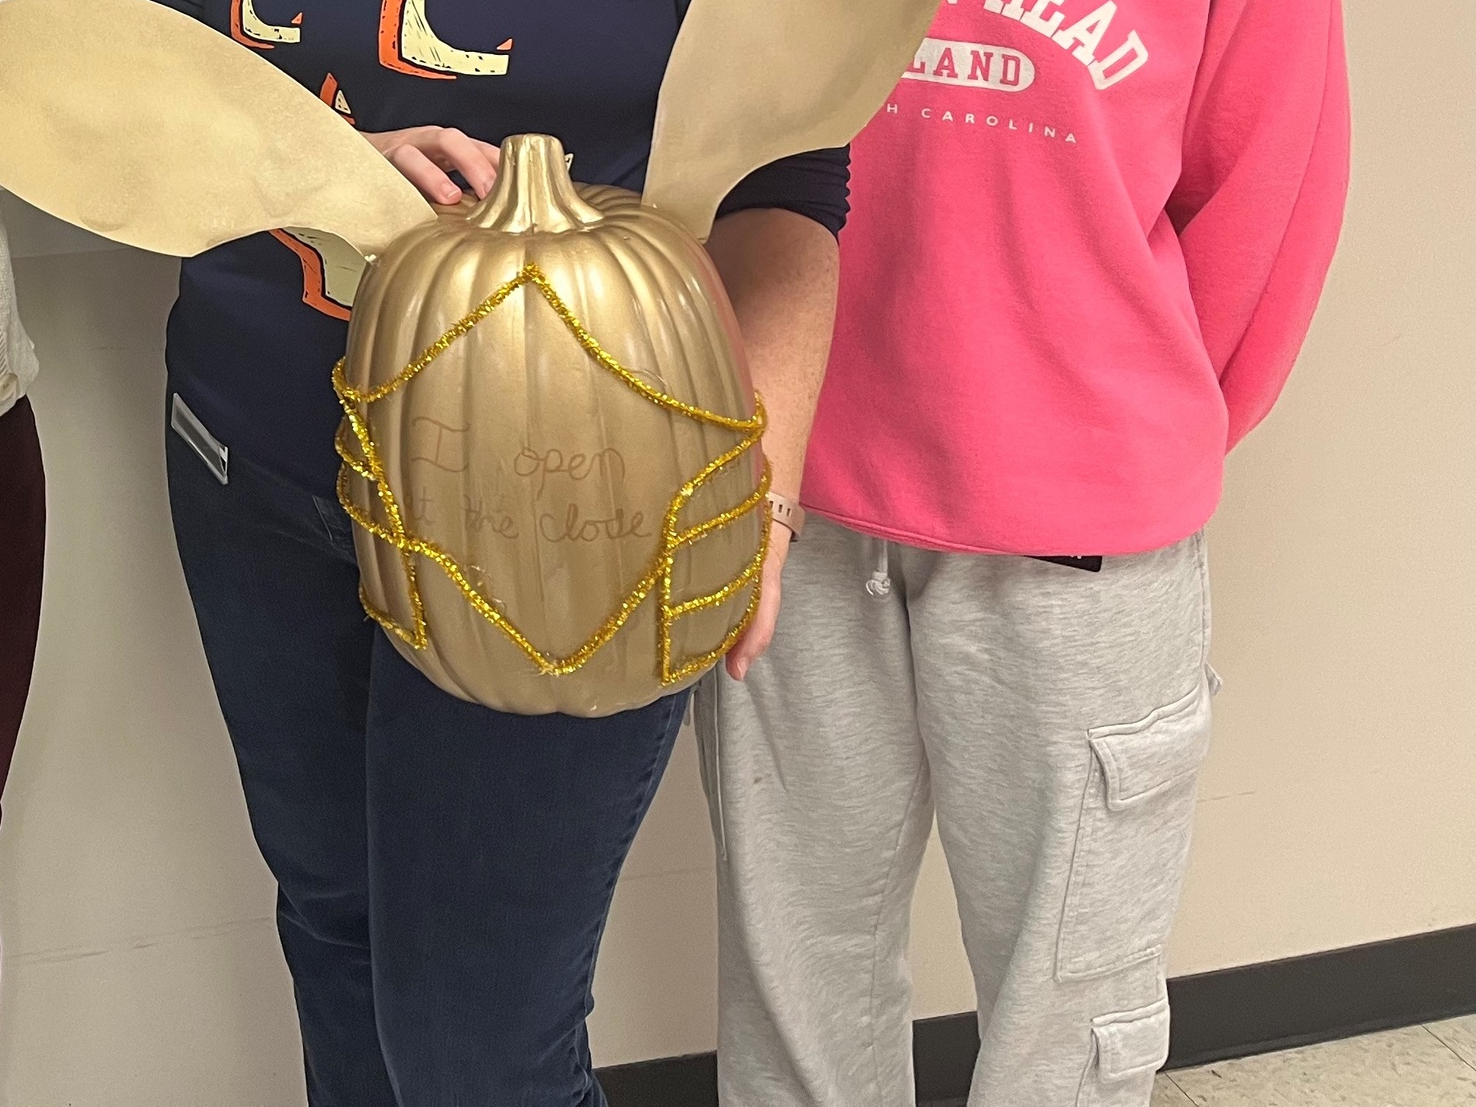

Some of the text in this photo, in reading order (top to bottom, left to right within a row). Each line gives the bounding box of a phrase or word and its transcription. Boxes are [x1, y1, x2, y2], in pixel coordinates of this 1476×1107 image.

[906, 47, 1021, 87] LAND
[921, 107, 1077, 144] CAROLINA
[411, 416, 627, 501] I open
[461, 493, 520, 539] the
